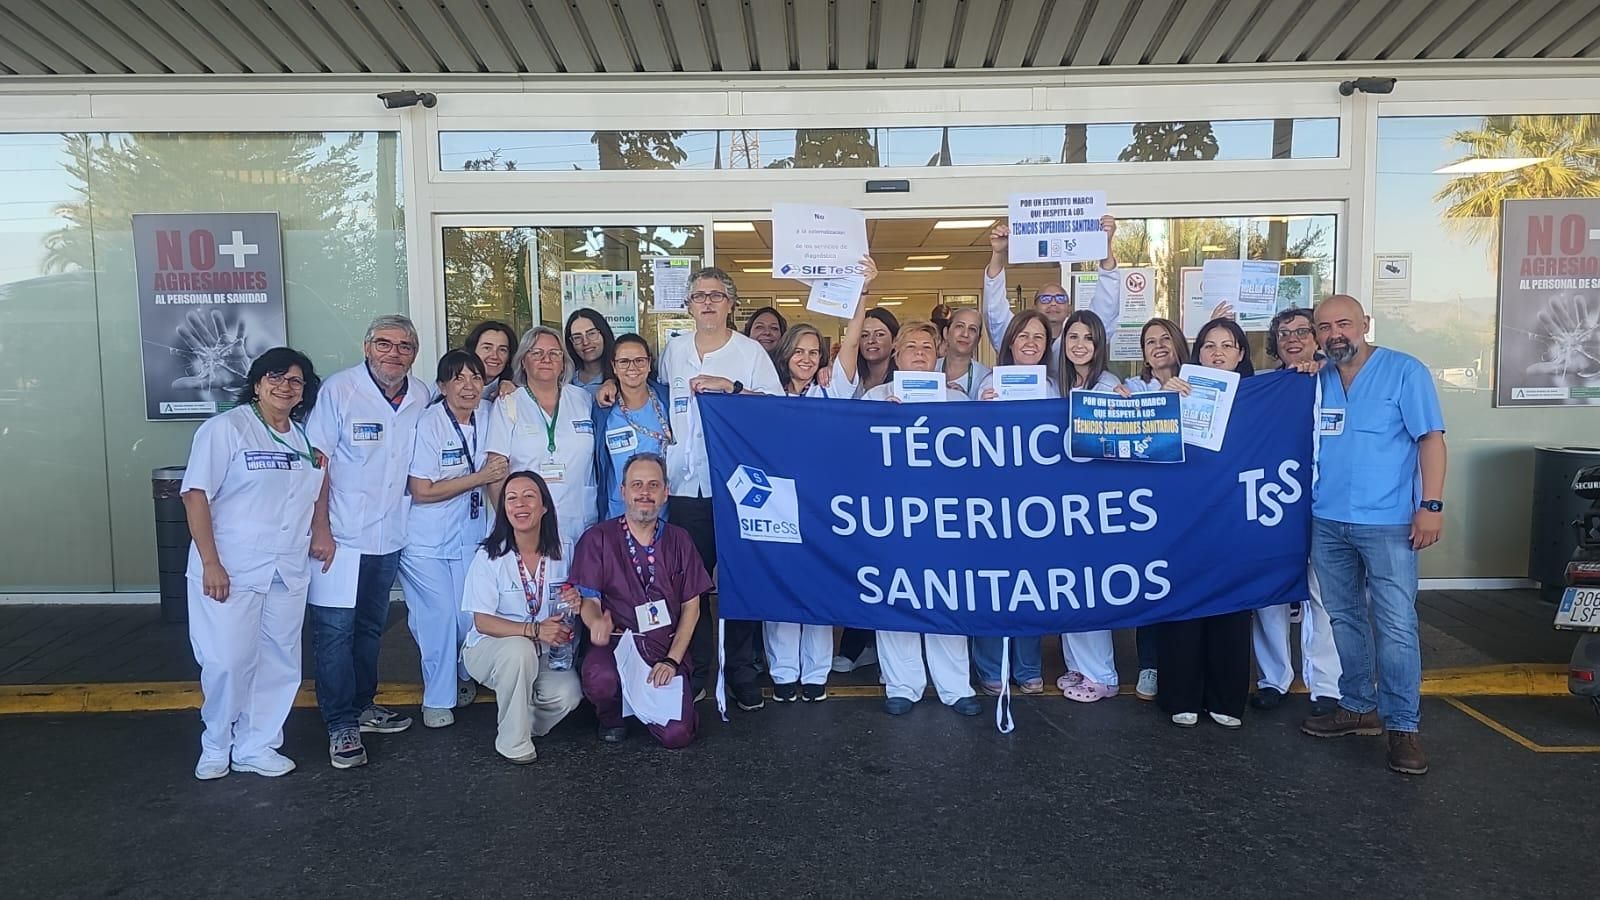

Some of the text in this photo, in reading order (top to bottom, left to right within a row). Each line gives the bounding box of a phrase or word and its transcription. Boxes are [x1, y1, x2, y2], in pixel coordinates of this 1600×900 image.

[1043, 198, 1071, 206] ESTATUTO
[1073, 196, 1093, 205] MARCO
[1031, 208, 1084, 218] QUE RESPETE A LOS
[1039, 220, 1071, 234] SUPERIORES
[1072, 218, 1104, 233] SANITARIOS
[1520, 256, 1600, 277] AGRESIO
[154, 271, 267, 291] AGRESIONES
[1520, 279, 1531, 290] AL
[1532, 279, 1577, 290] PERSONAL
[1578, 279, 1590, 289] DE
[155, 293, 268, 305] AL PERSONAL DE SANIDAD
[1083, 397, 1096, 406] POR
[1108, 399, 1140, 408] ESTATUTO
[1141, 397, 1166, 406] MARCO
[1093, 409, 1156, 418] QUE RESPETE A LOS
[1073, 418, 1179, 434] TÉCNICOS SUPERIORES SANITARIOS
[870, 415, 1093, 468] TÉCNIC
[1238, 459, 1302, 527] TSS
[830, 488, 1158, 539] SUPERIORES
[741, 518, 798, 535] SIETeSS
[856, 560, 1171, 612] SANITARIOS
